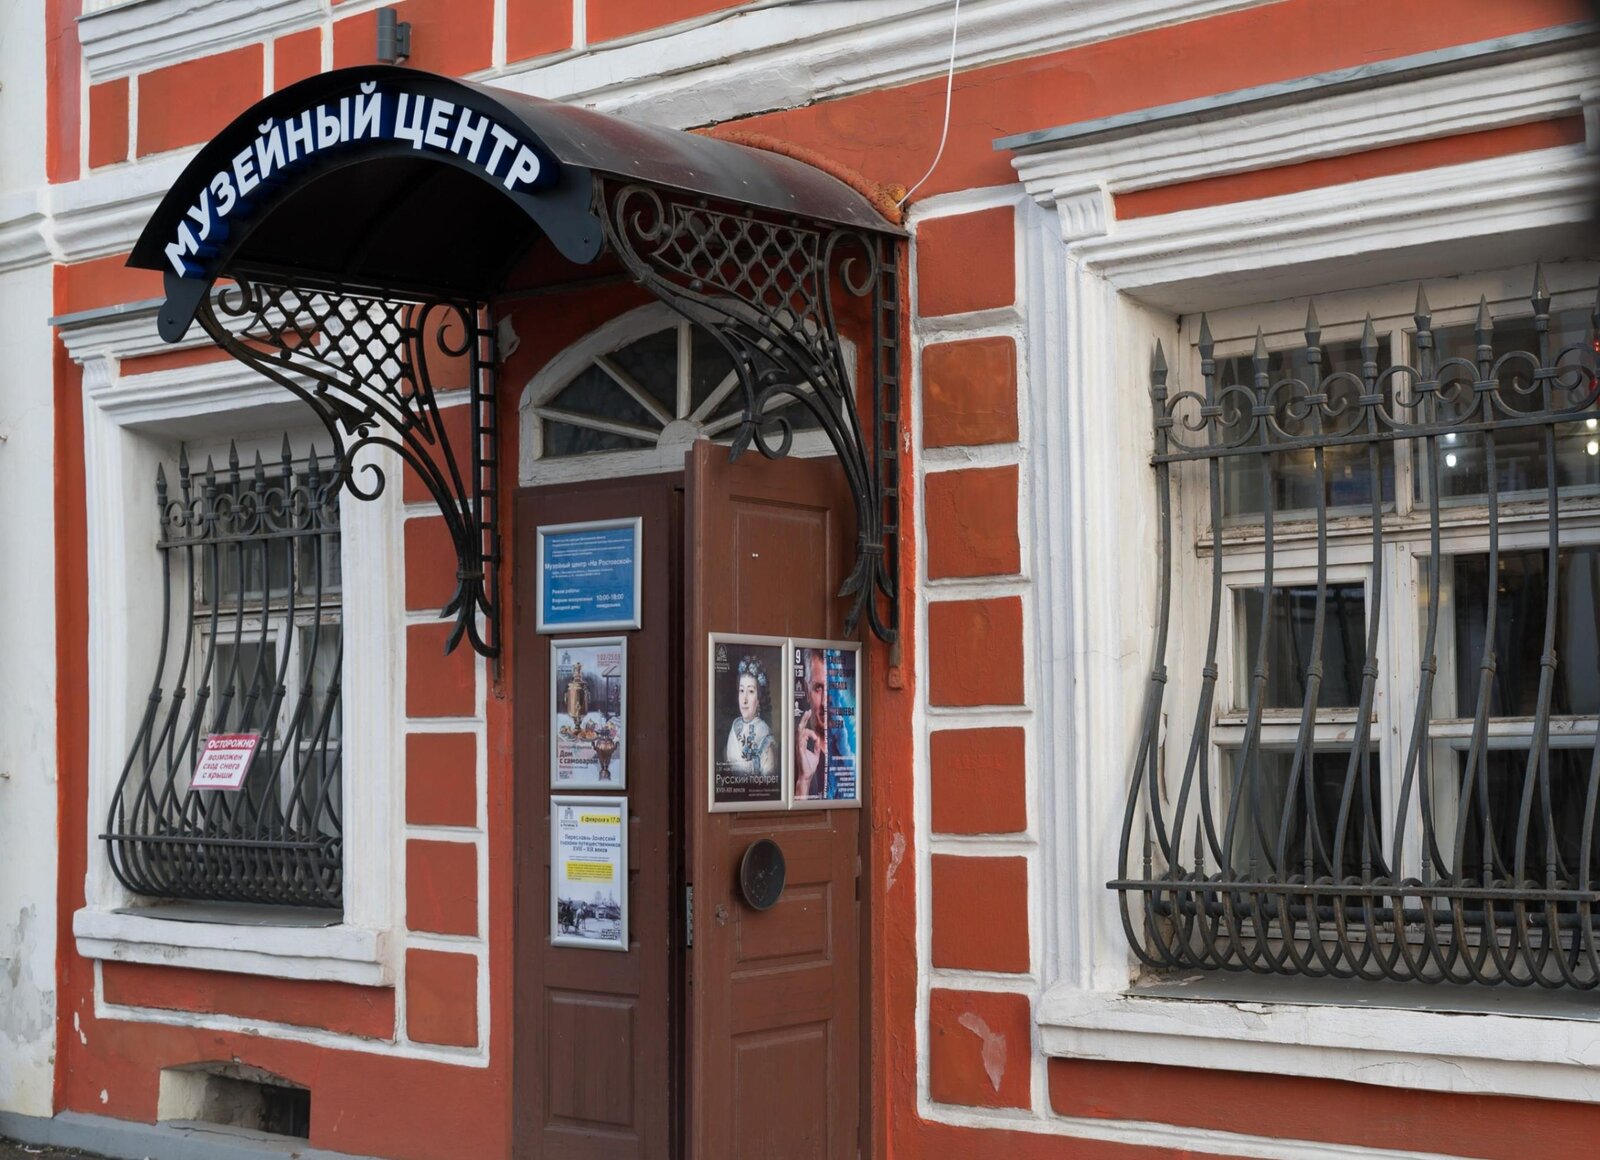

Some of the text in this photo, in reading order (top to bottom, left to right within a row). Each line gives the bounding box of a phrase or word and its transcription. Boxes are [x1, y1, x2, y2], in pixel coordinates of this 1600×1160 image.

[164, 80, 541, 278] МУЗЕЙНЫЙ ЦЕНТР
[544, 561, 571, 571] Музейный
[571, 561, 587, 569] центр
[795, 649, 801, 664] 9
[208, 739, 256, 749] ОСТОРОЖНО
[559, 750, 573, 759] Дом
[202, 763, 219, 771] сход
[564, 758, 599, 766] самоваром
[208, 772, 233, 780] крыши
[715, 773, 779, 786] Русский портрет
